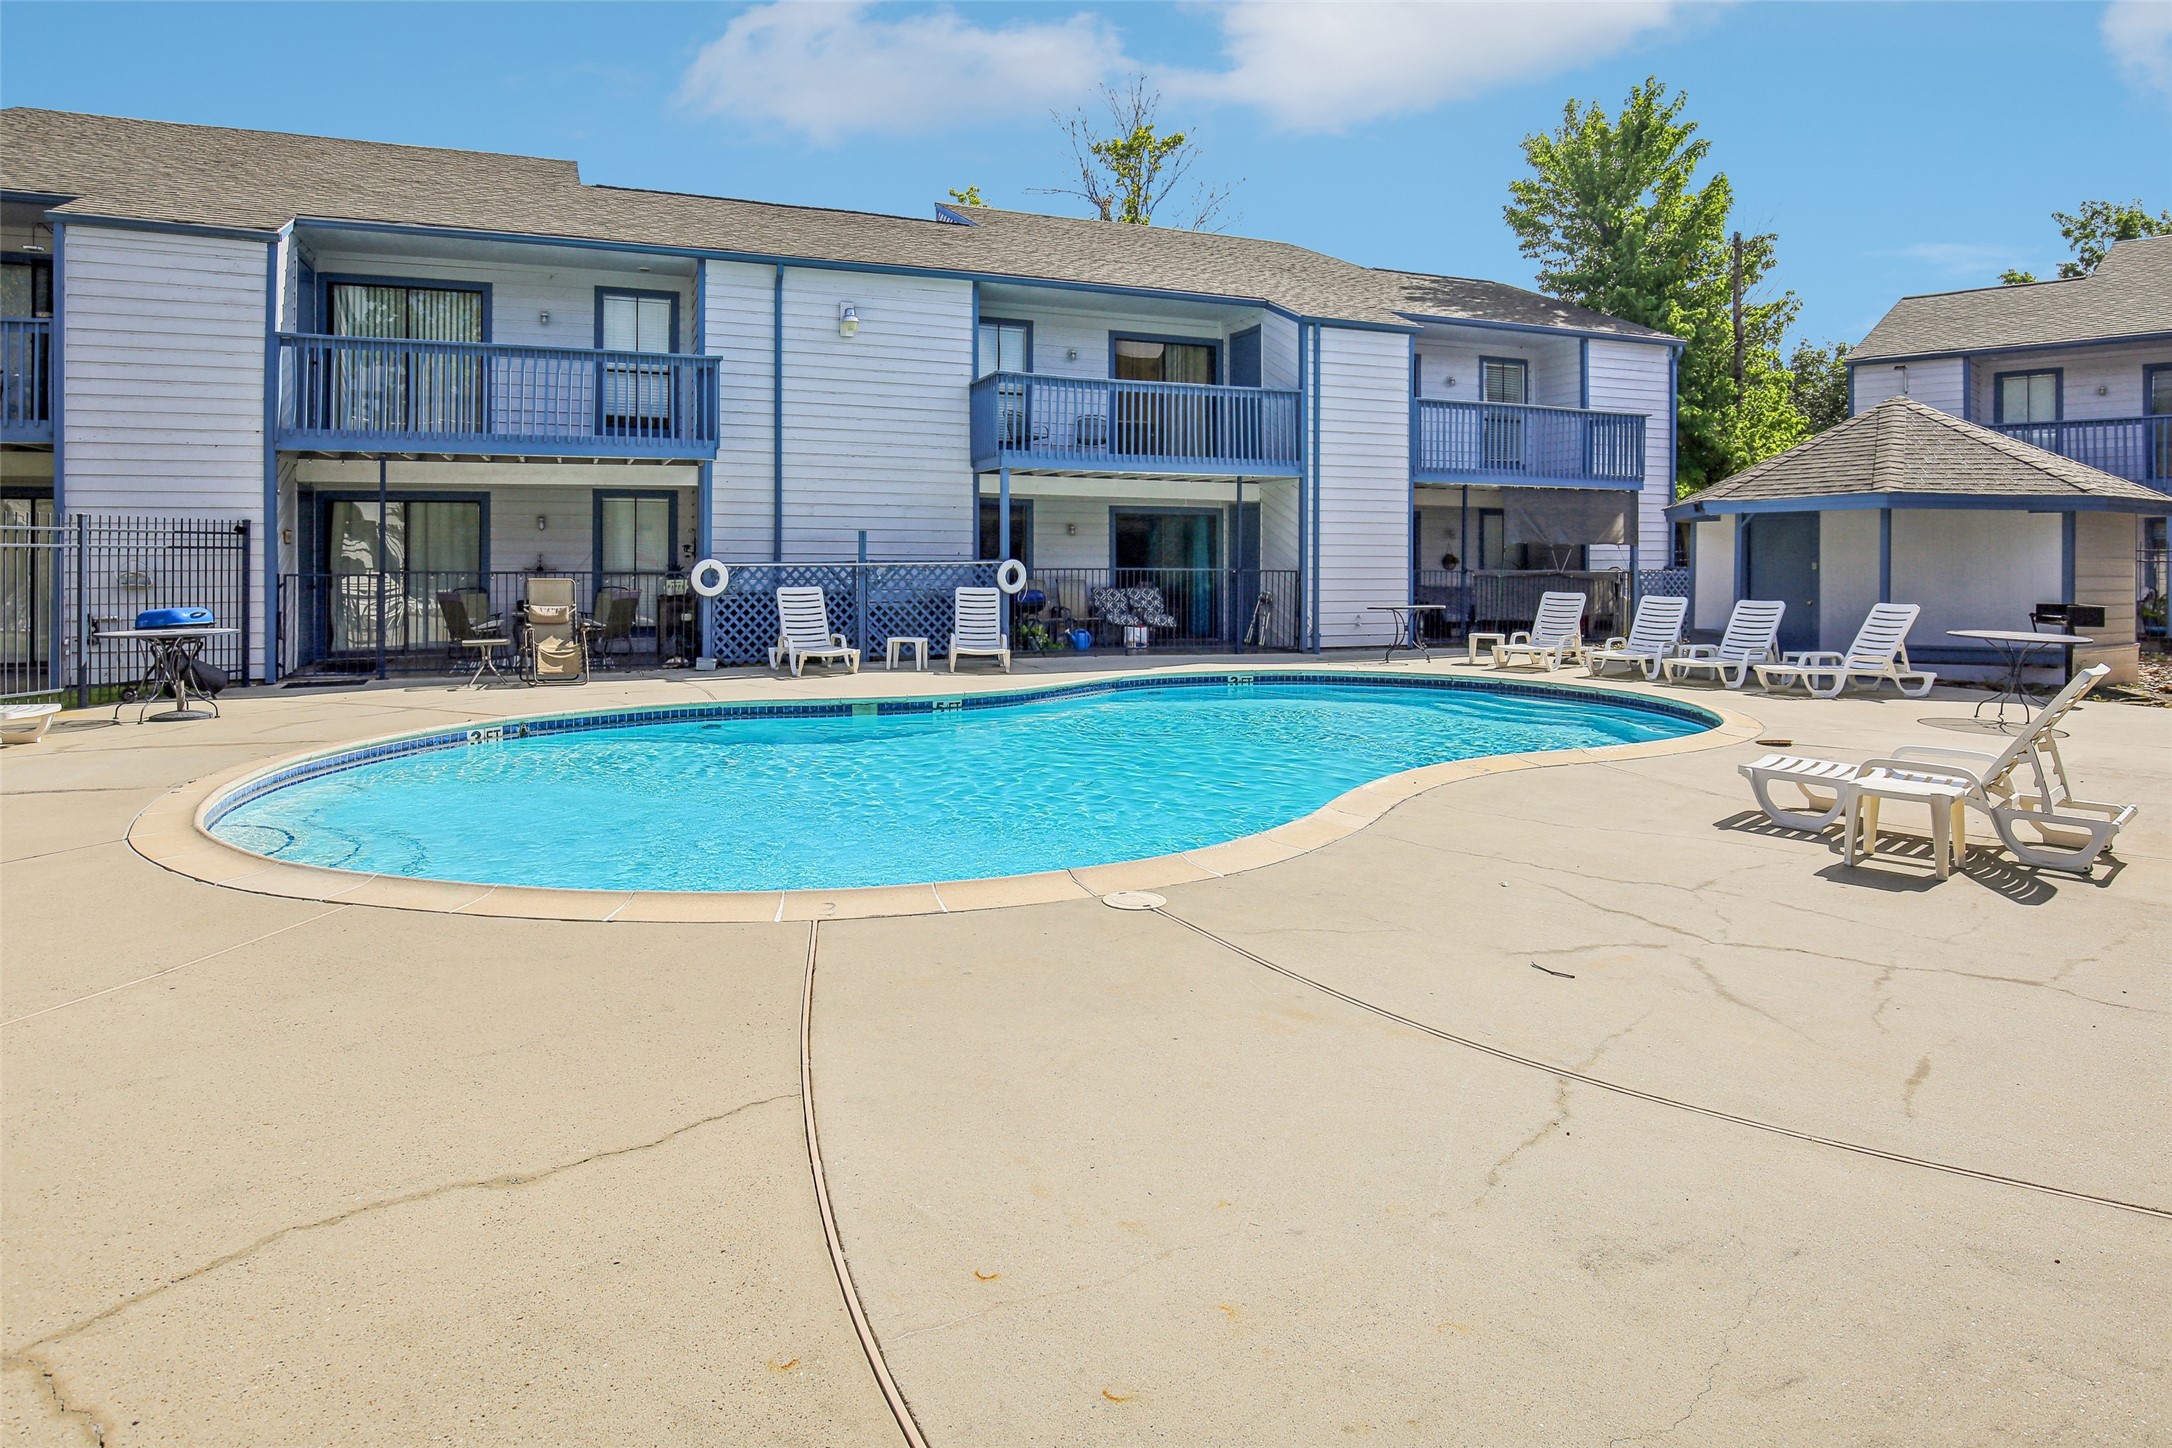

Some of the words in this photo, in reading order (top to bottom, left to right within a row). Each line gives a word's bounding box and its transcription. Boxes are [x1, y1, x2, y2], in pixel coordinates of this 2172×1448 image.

[1230, 676, 1239, 686] 3
[1241, 677, 1252, 686] FT
[936, 702, 944, 712] 5
[949, 701, 960, 712] FT
[471, 731, 482, 745] 3
[487, 729, 501, 743] FT
